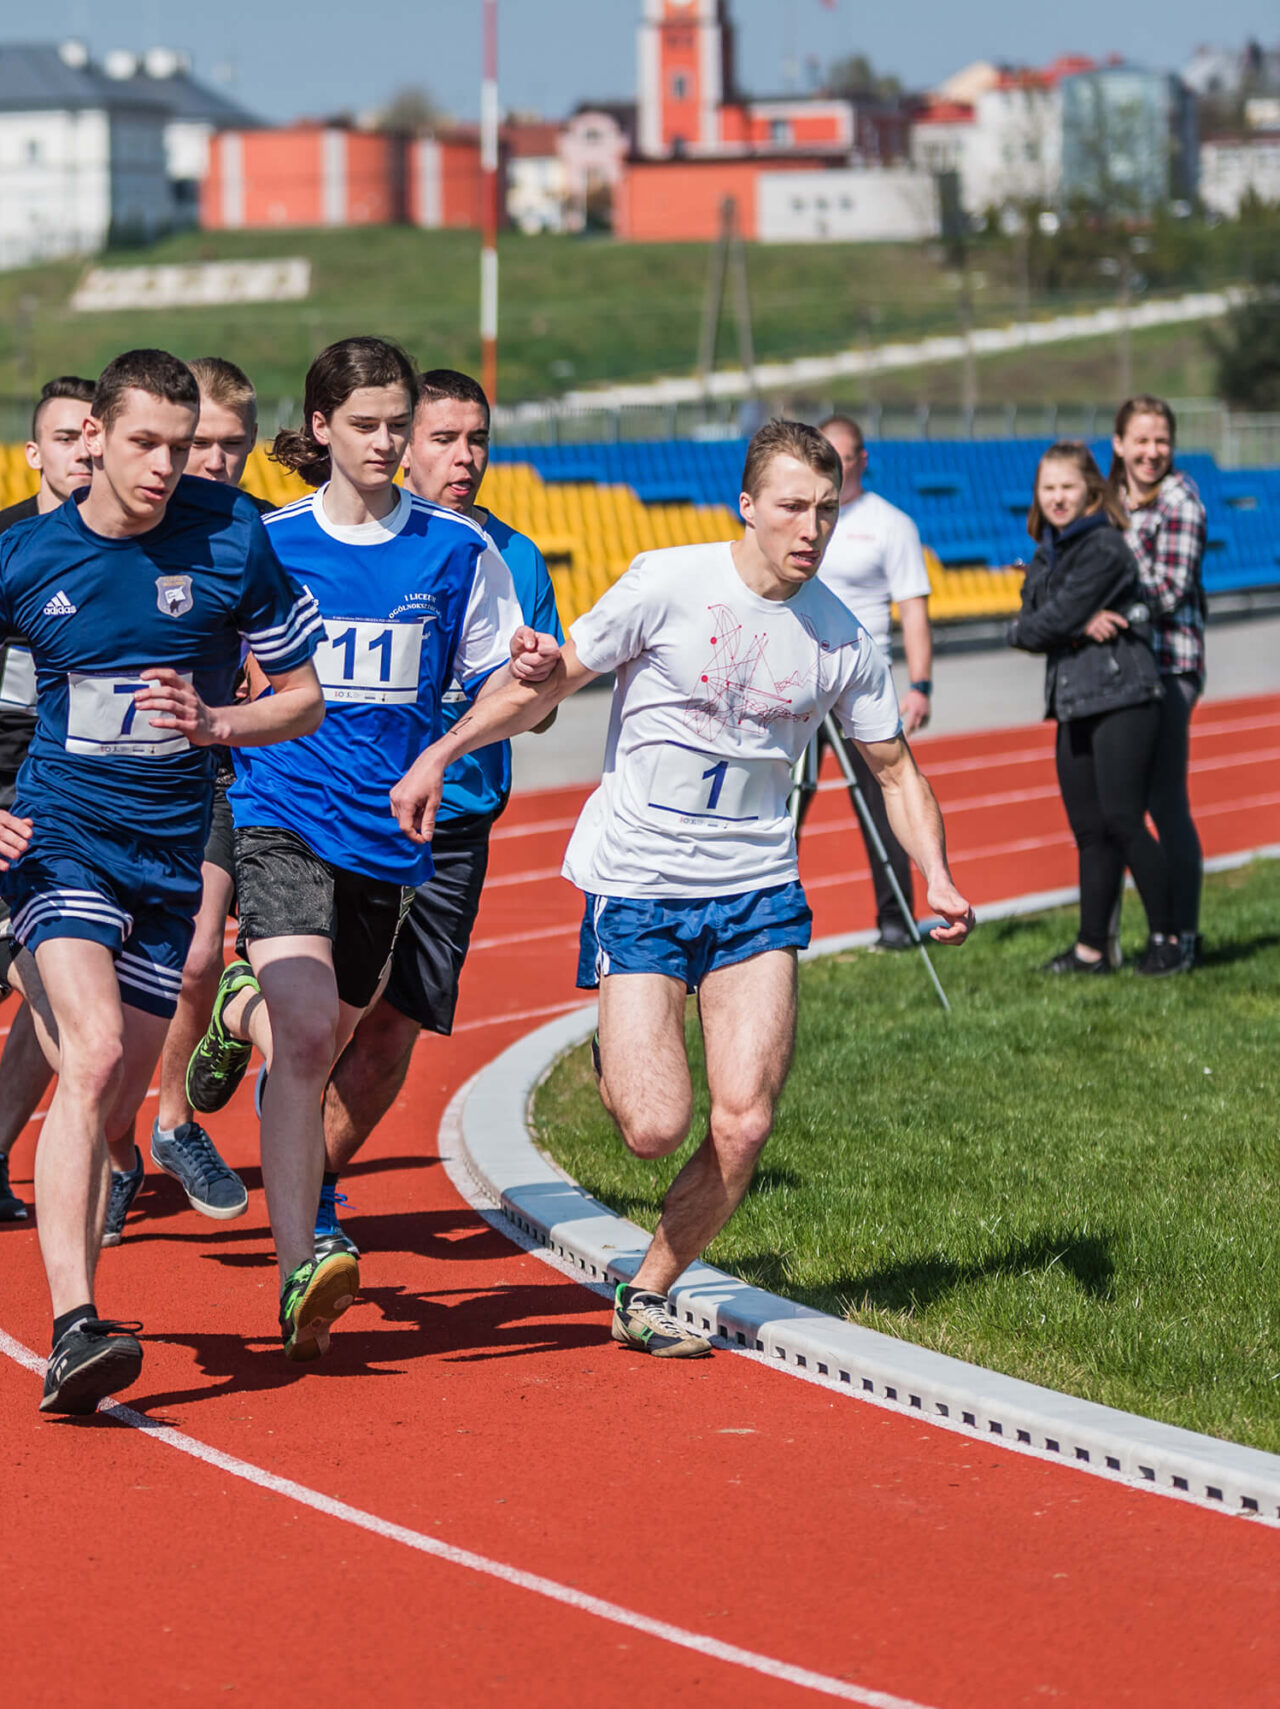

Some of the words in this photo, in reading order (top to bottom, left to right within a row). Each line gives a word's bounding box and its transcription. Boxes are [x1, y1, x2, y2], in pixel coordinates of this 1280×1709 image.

[43, 605, 77, 615] adidas
[332, 627, 393, 682] 11
[113, 684, 150, 735] 7
[701, 760, 729, 810] 1
